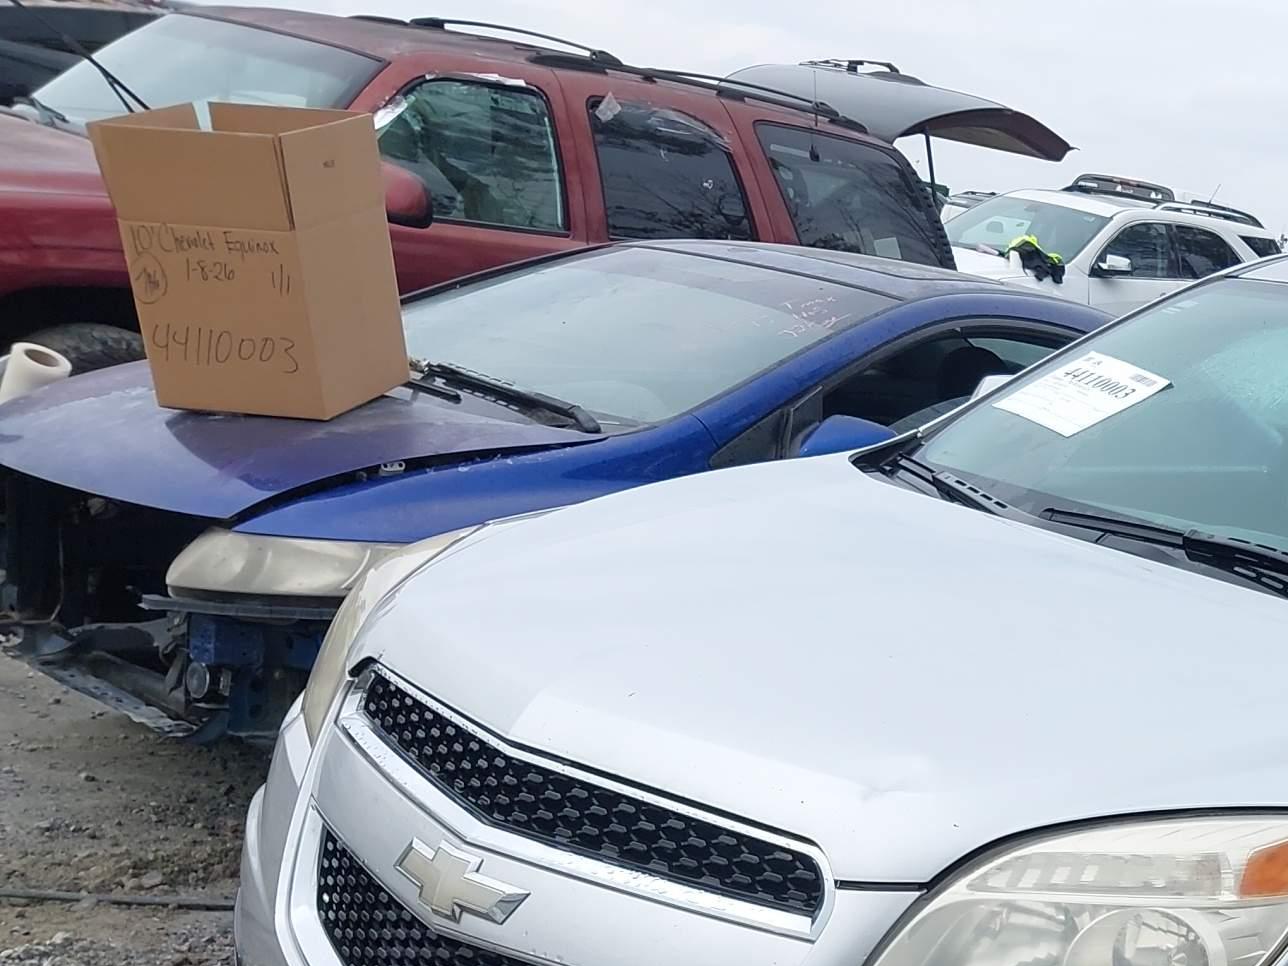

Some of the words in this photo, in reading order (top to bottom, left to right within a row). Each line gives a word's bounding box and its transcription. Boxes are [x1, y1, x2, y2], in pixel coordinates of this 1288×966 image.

[186, 257, 235, 281] 1-8-26
[152, 323, 298, 373] 44110003
[1064, 368, 1136, 399] 44110003
